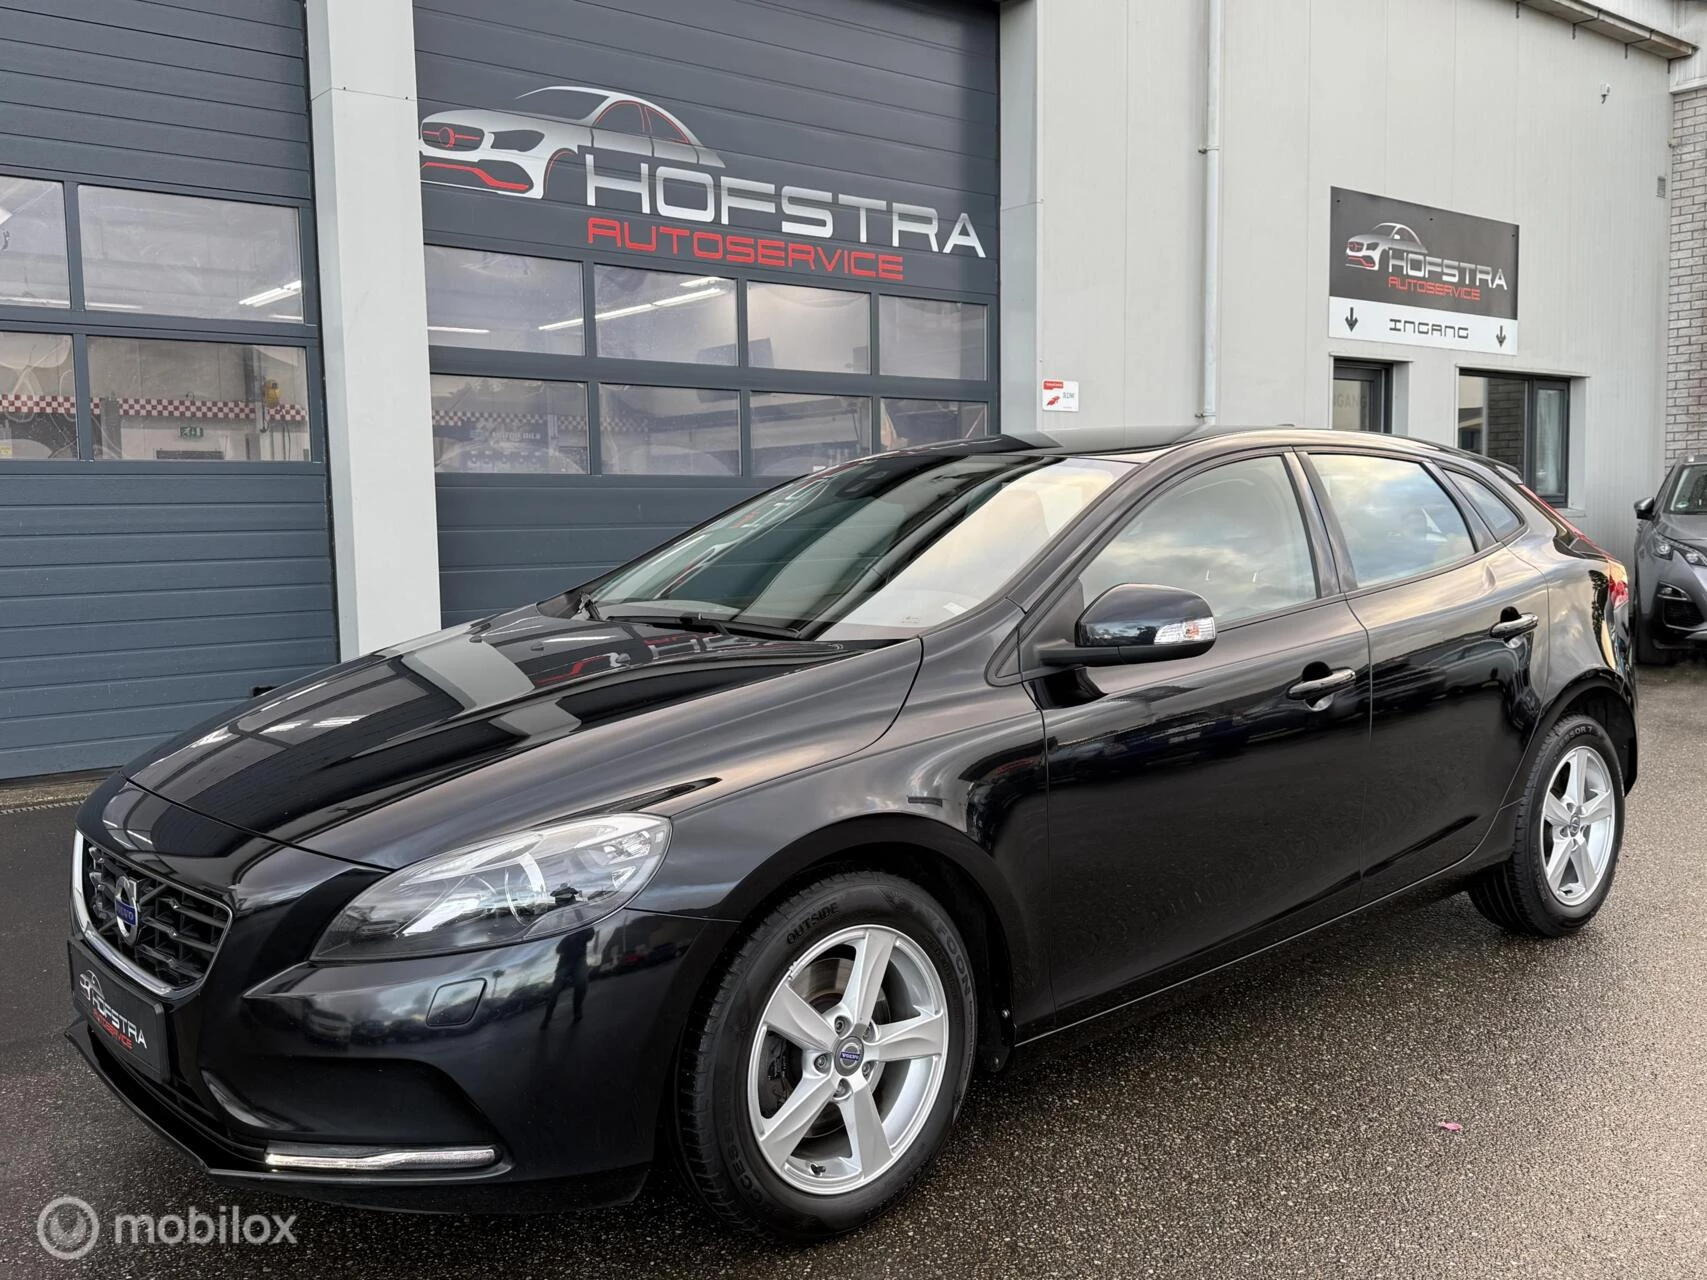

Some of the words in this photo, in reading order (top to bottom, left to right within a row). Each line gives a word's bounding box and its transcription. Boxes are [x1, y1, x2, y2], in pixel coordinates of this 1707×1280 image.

[585, 153, 986, 258] HOFSTRA
[587, 217, 904, 281] AUTOSERVICE
[1388, 250, 1508, 290] HOFSTRA
[1388, 277, 1481, 301] AUTOSERVICE
[1389, 318, 1469, 339] INGANG
[787, 902, 840, 945] OUTSIDE
[92, 991, 148, 1050] HOFSTRA
